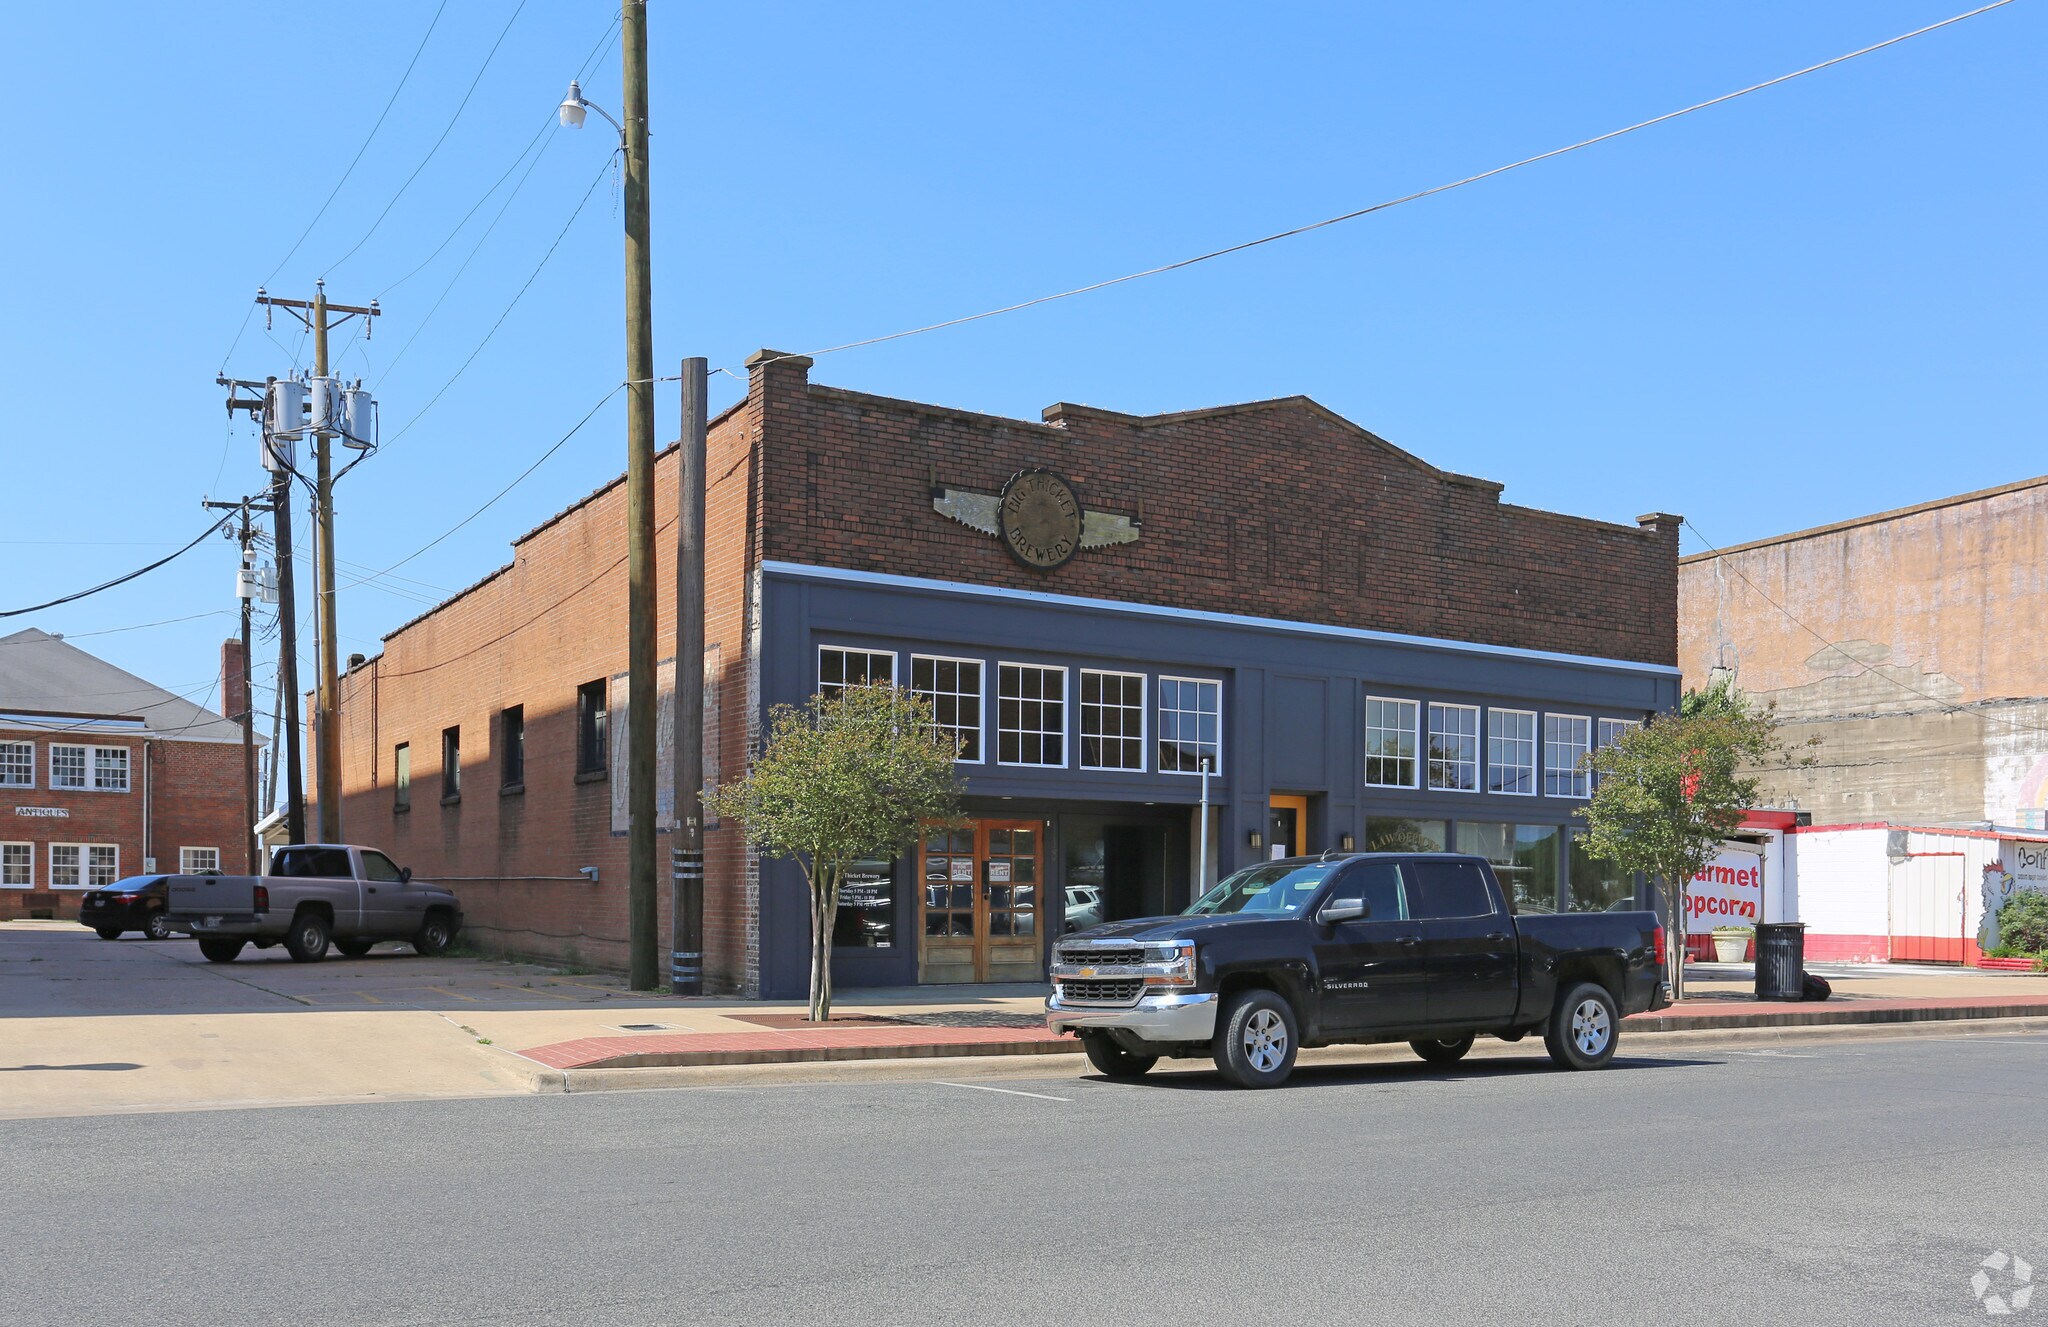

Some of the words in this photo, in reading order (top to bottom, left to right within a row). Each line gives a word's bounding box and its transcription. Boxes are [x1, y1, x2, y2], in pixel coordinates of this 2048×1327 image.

[1008, 488, 1026, 514] BIG
[1026, 478, 1076, 520] THICKET
[1009, 527, 1073, 562] BREWERY
[17, 807, 68, 817] ANTIQUES
[1371, 833, 1394, 851] LAW
[1682, 864, 1759, 888] urmet
[1685, 894, 1756, 919] opcorn
